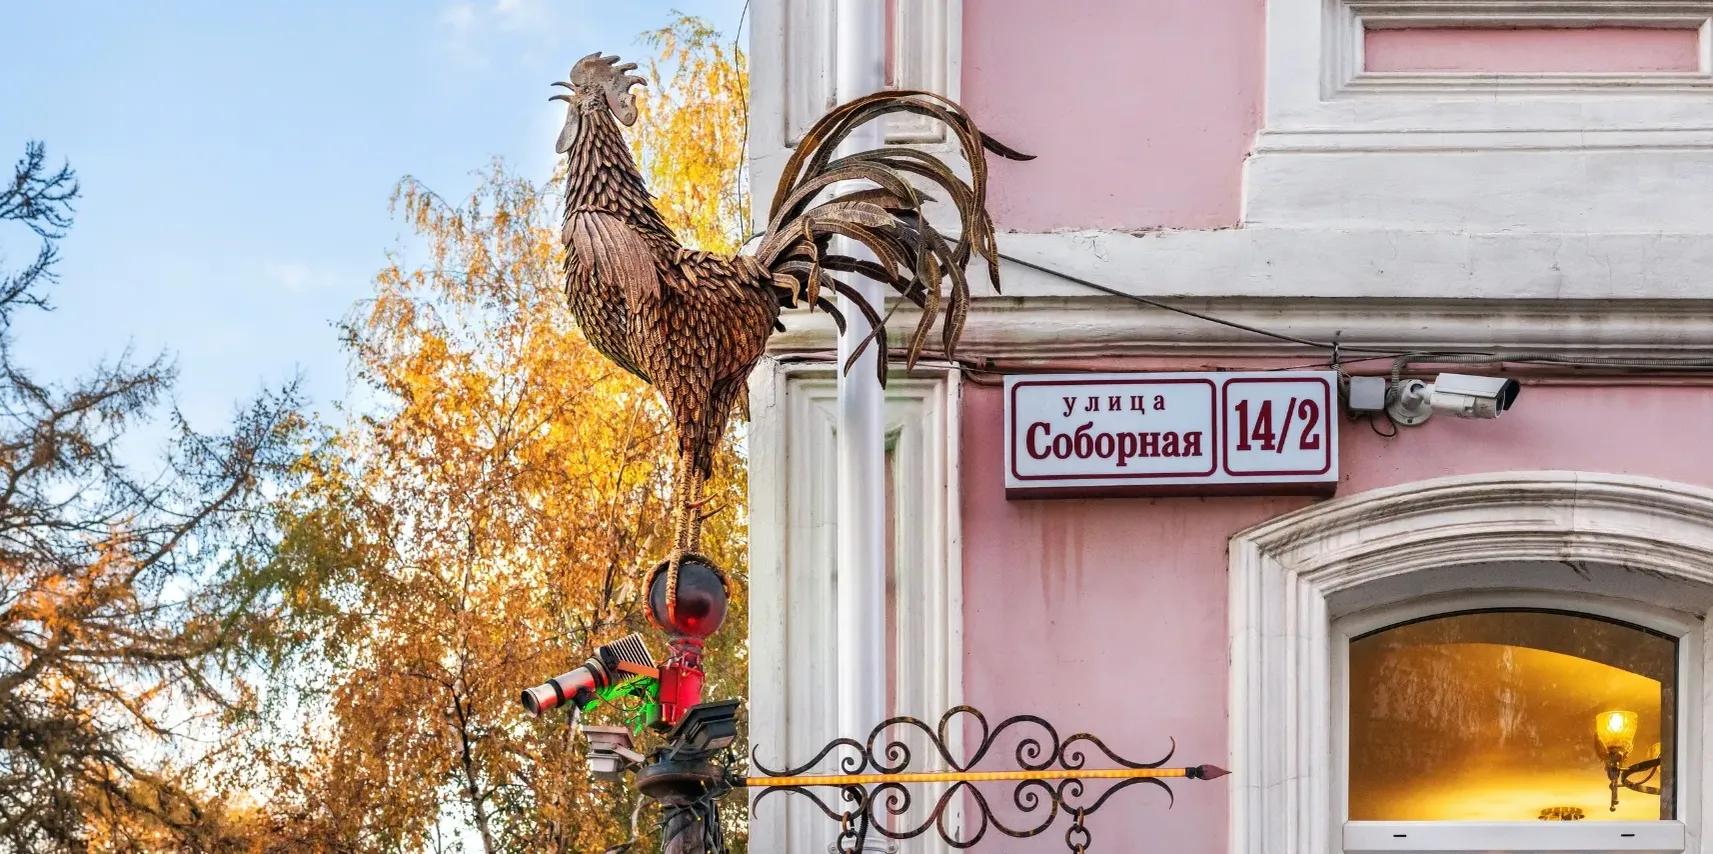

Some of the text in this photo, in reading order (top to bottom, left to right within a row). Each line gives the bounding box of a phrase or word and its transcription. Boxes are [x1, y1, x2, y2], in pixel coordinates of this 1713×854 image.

[1062, 394, 1167, 418] улица
[1234, 397, 1321, 454] 14/2
[1025, 421, 1203, 468] Соборная
